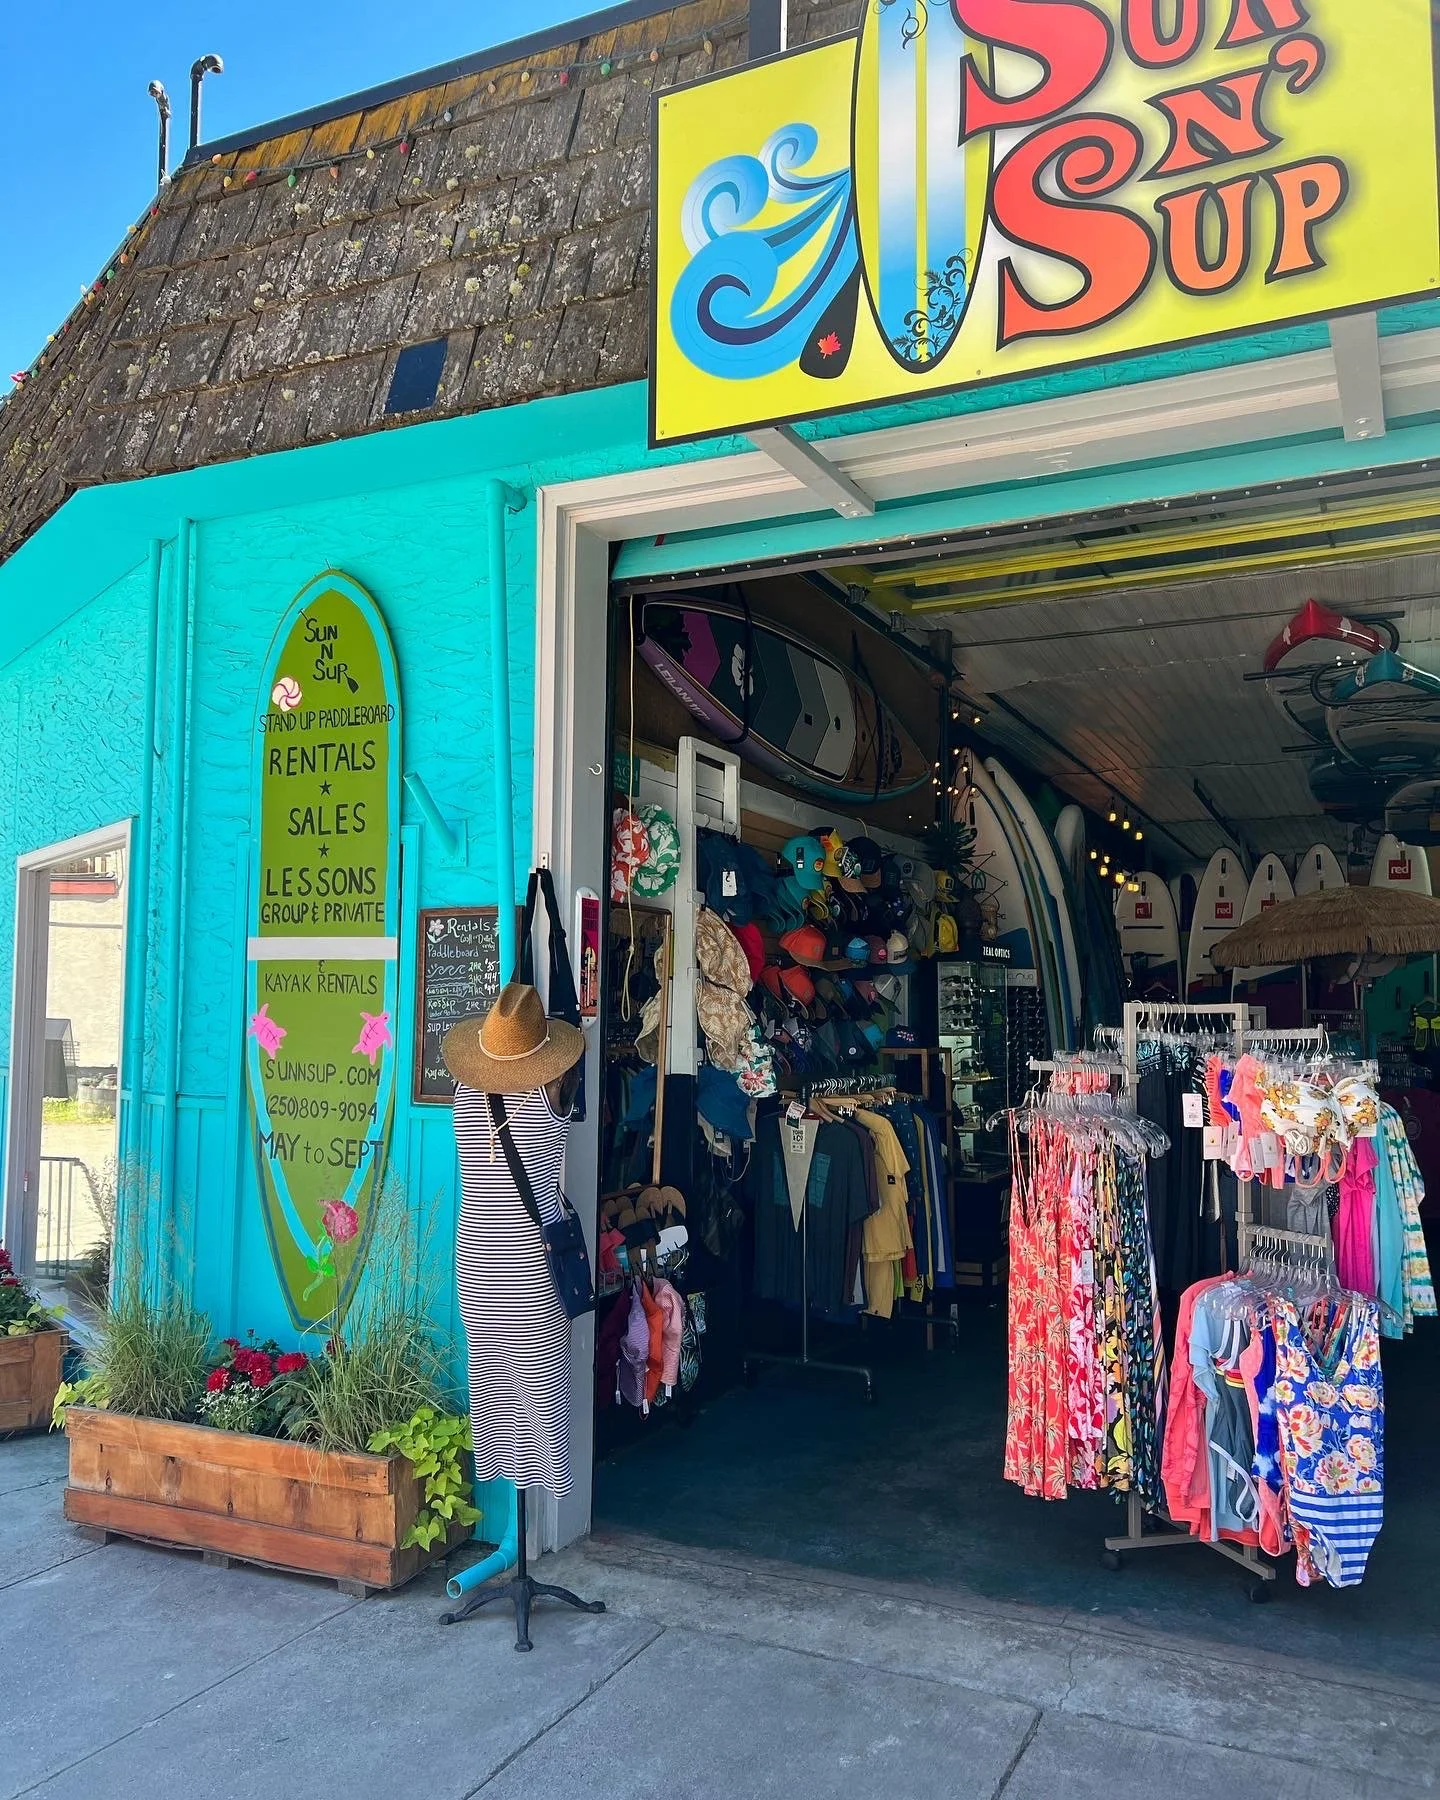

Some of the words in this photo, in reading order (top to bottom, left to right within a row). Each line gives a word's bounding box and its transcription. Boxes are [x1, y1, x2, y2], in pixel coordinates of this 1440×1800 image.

[320, 643, 334, 660] N
[258, 712, 297, 733] STAND
[300, 710, 316, 731] UP
[319, 703, 395, 729] PADDLEBOARD
[269, 740, 376, 776] RENTALS
[288, 802, 366, 836] SALES
[1391, 860, 1409, 874] red
[266, 866, 377, 897] LESSONS
[261, 902, 310, 925] GROUP
[311, 902, 320, 925] &
[324, 901, 385, 923] PRIVATE
[1216, 903, 1232, 915] red
[447, 917, 491, 938] Rentals
[428, 943, 479, 959] Paddleboard
[265, 972, 312, 994] KAYAK
[318, 973, 378, 995] RENTALS
[265, 1058, 381, 1086] SUNNSUP.COM
[265, 1094, 378, 1125] (250)809-9094
[258, 1131, 301, 1162] MAY
[304, 1140, 325, 1164] to
[327, 1137, 385, 1170] SEPT
